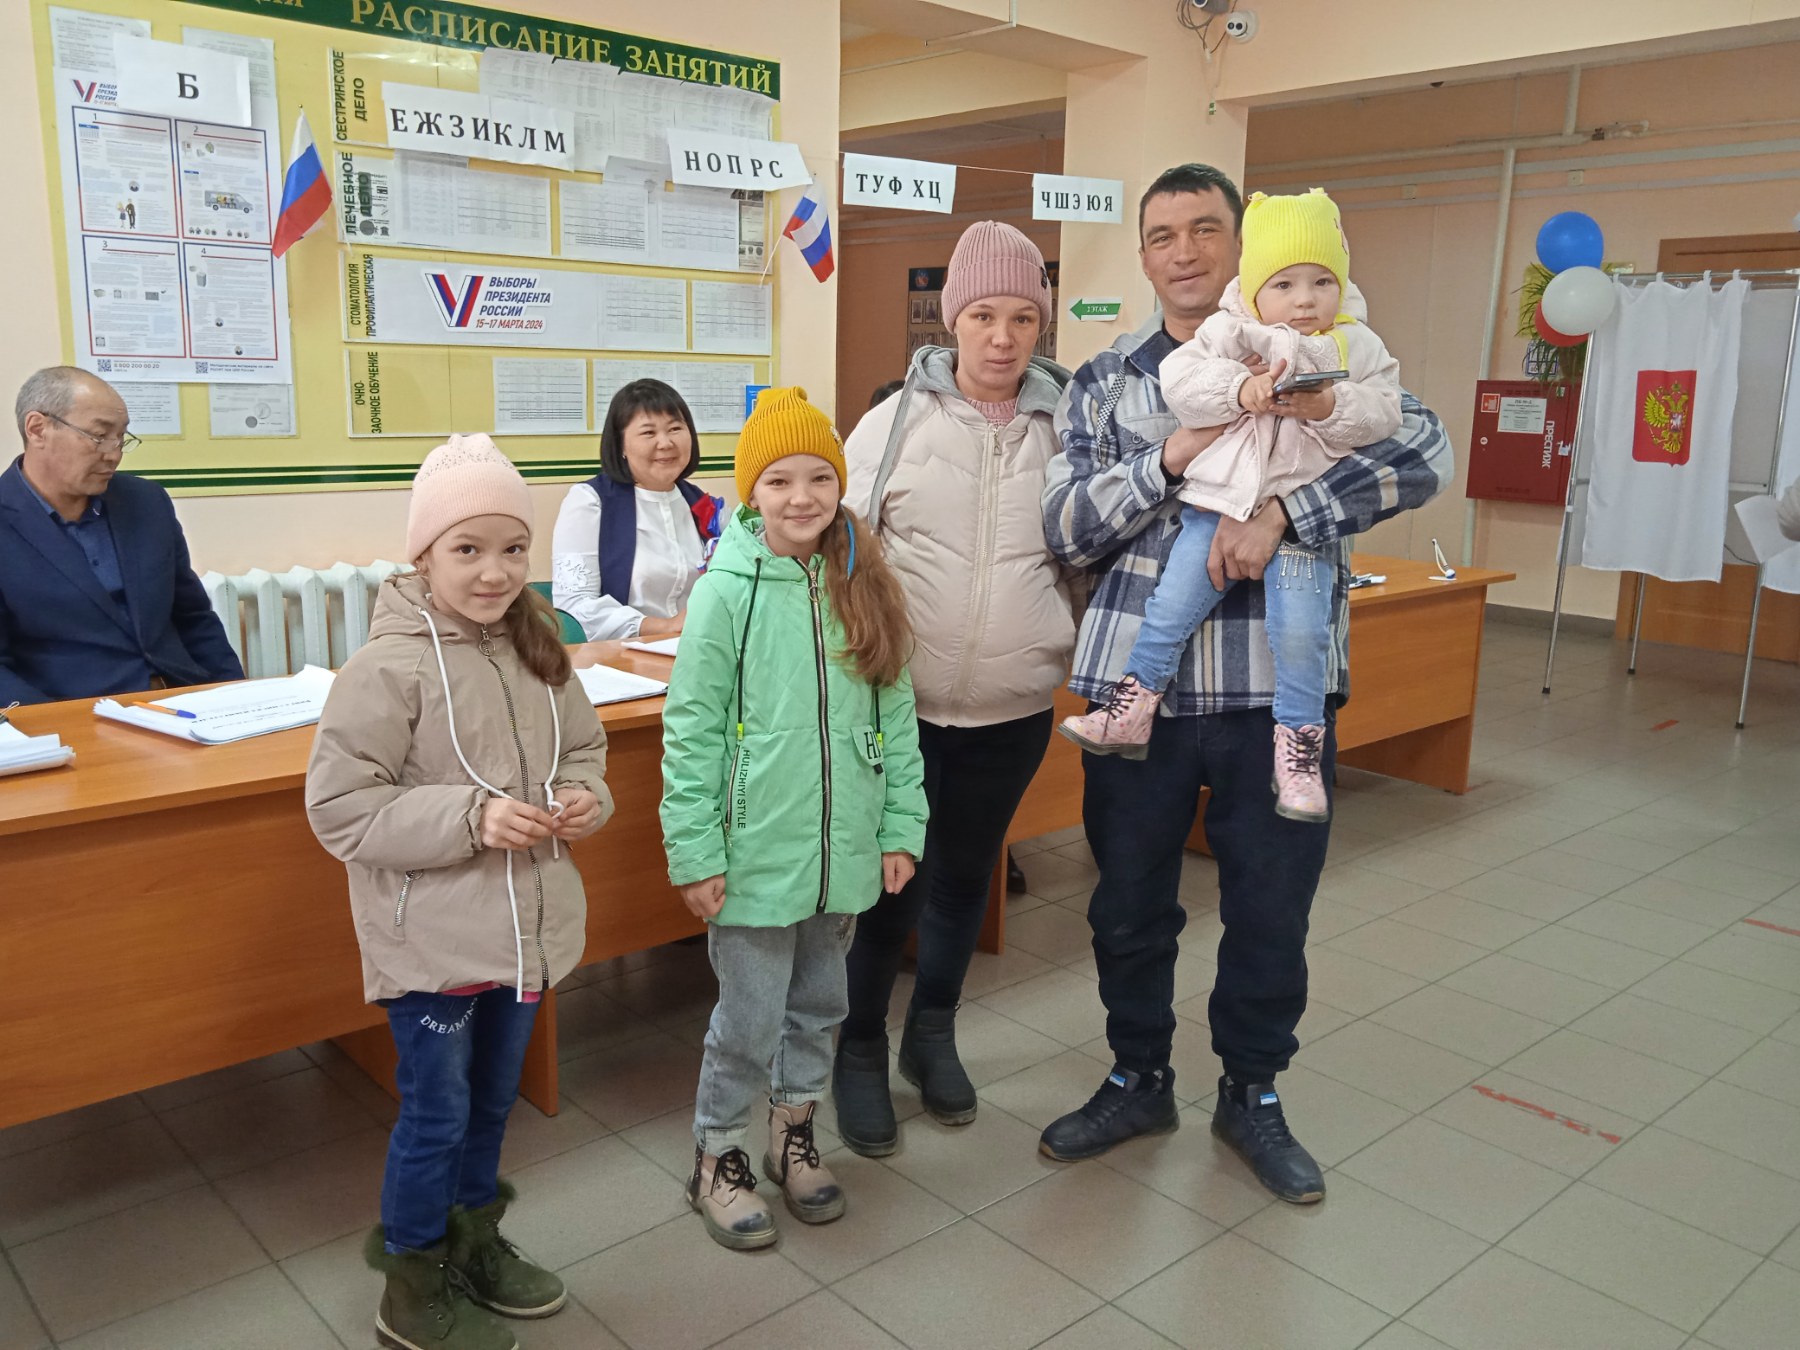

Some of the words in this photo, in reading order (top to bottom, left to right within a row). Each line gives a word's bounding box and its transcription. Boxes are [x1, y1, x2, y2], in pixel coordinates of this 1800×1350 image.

[350, 0, 612, 65] РАСПИСАНИЕ
[625, 44, 772, 94] ЗАНЯТИЙ
[176, 72, 200, 100] Б
[332, 49, 347, 141] СЕСТРИНСКОЕ
[353, 77, 367, 122] ДЕЛО
[342, 151, 357, 236] ЛЕЧЕБНОЕ
[358, 174, 372, 217] ДЕЛО
[349, 263, 361, 326] СТОМАТОЛОГИЯ
[362, 253, 377, 337] ПРОФИЛАКТИЧЕСКАЯ
[484, 290, 551, 304] ПРЕЗИДЕНТА
[489, 276, 538, 289] ВЫБОРЫ
[479, 305, 524, 317] РОССИИ
[499, 319, 524, 330] МАРТА
[524, 320, 543, 330] 2024
[355, 380, 366, 406] ОЧНО-
[368, 351, 379, 394] ОБУЧЕНИЕ
[369, 395, 382, 434] ЗАОЧНОЕ
[1542, 420, 1555, 469] ПРЕСТИЖ
[738, 749, 750, 798] HULIZHIYI
[737, 799, 747, 829] STYLE
